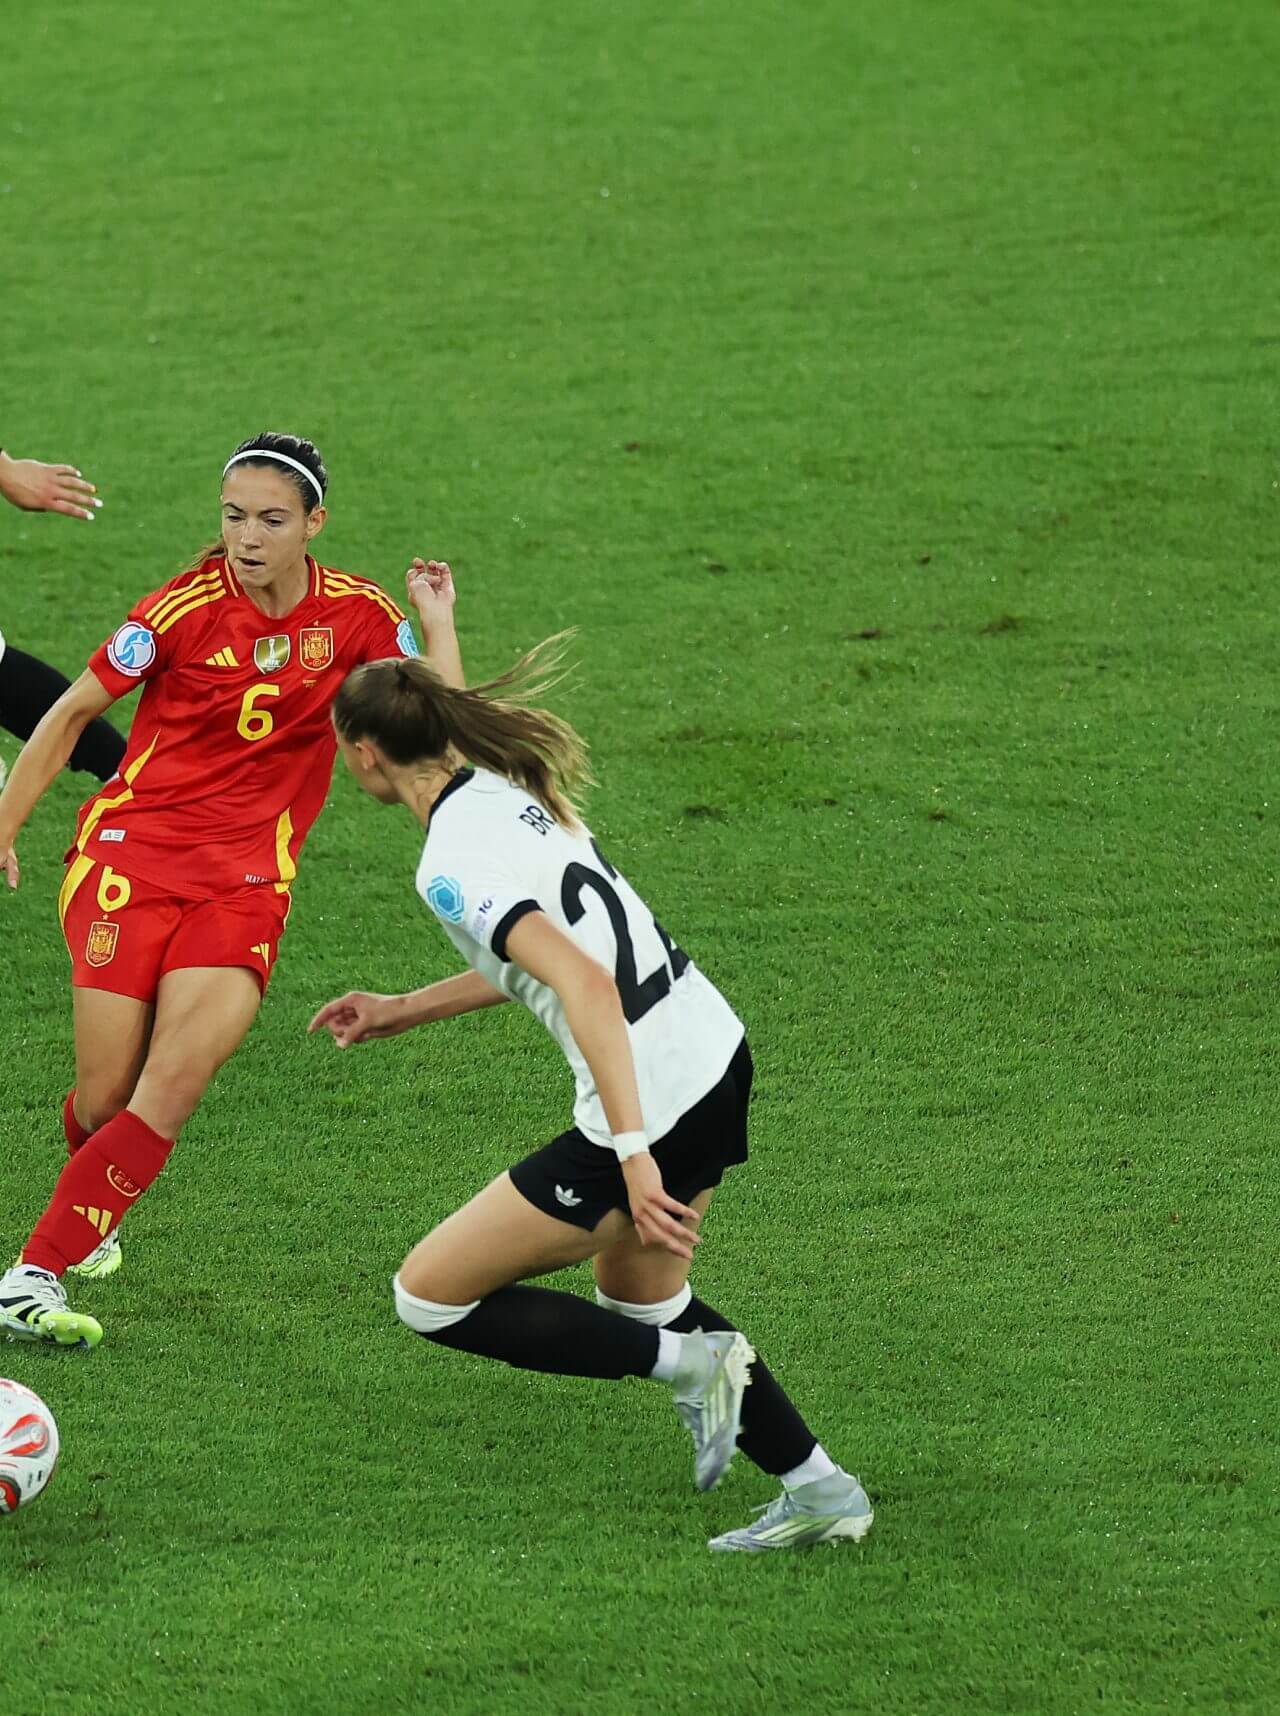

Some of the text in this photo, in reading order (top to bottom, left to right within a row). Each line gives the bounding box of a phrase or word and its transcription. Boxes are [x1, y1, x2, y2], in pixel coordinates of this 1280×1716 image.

[236, 683, 280, 741] 6
[519, 805, 557, 836] BR
[97, 865, 132, 912] 6
